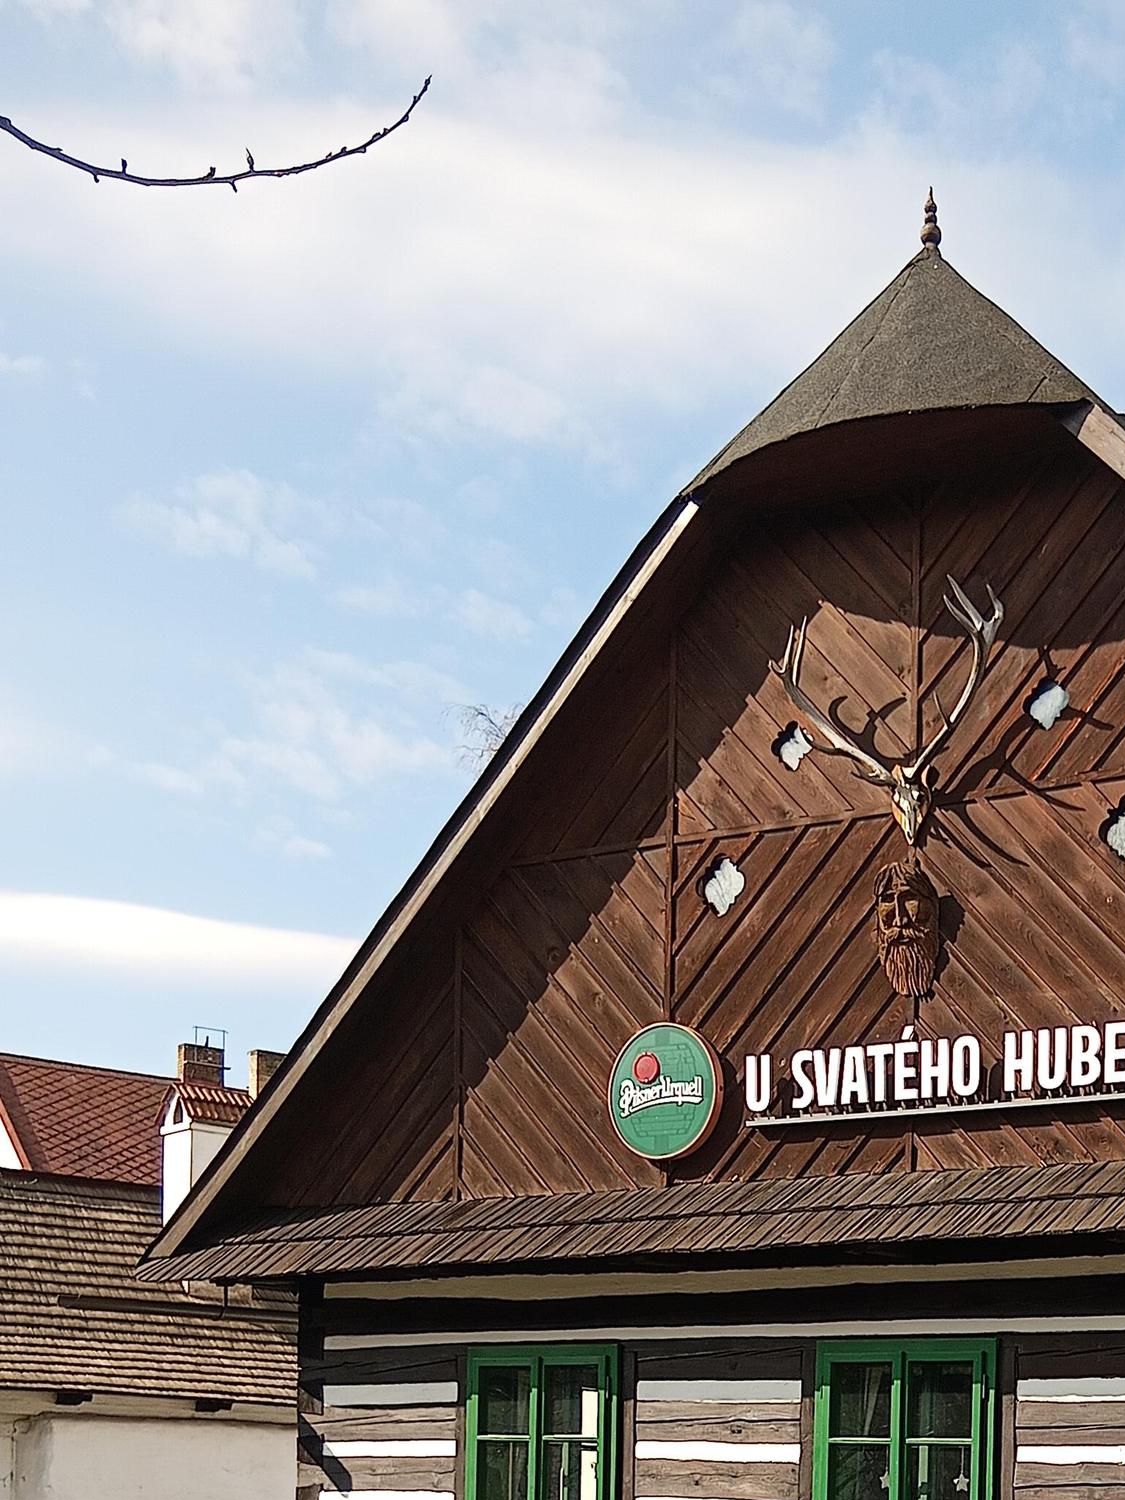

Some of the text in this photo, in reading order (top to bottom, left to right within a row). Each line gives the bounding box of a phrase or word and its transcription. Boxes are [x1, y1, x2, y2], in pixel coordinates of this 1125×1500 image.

[620, 1075, 703, 1117] Pilsner Urquell
[745, 1053, 771, 1112] U
[791, 1025, 980, 1109] SVATÉHO
